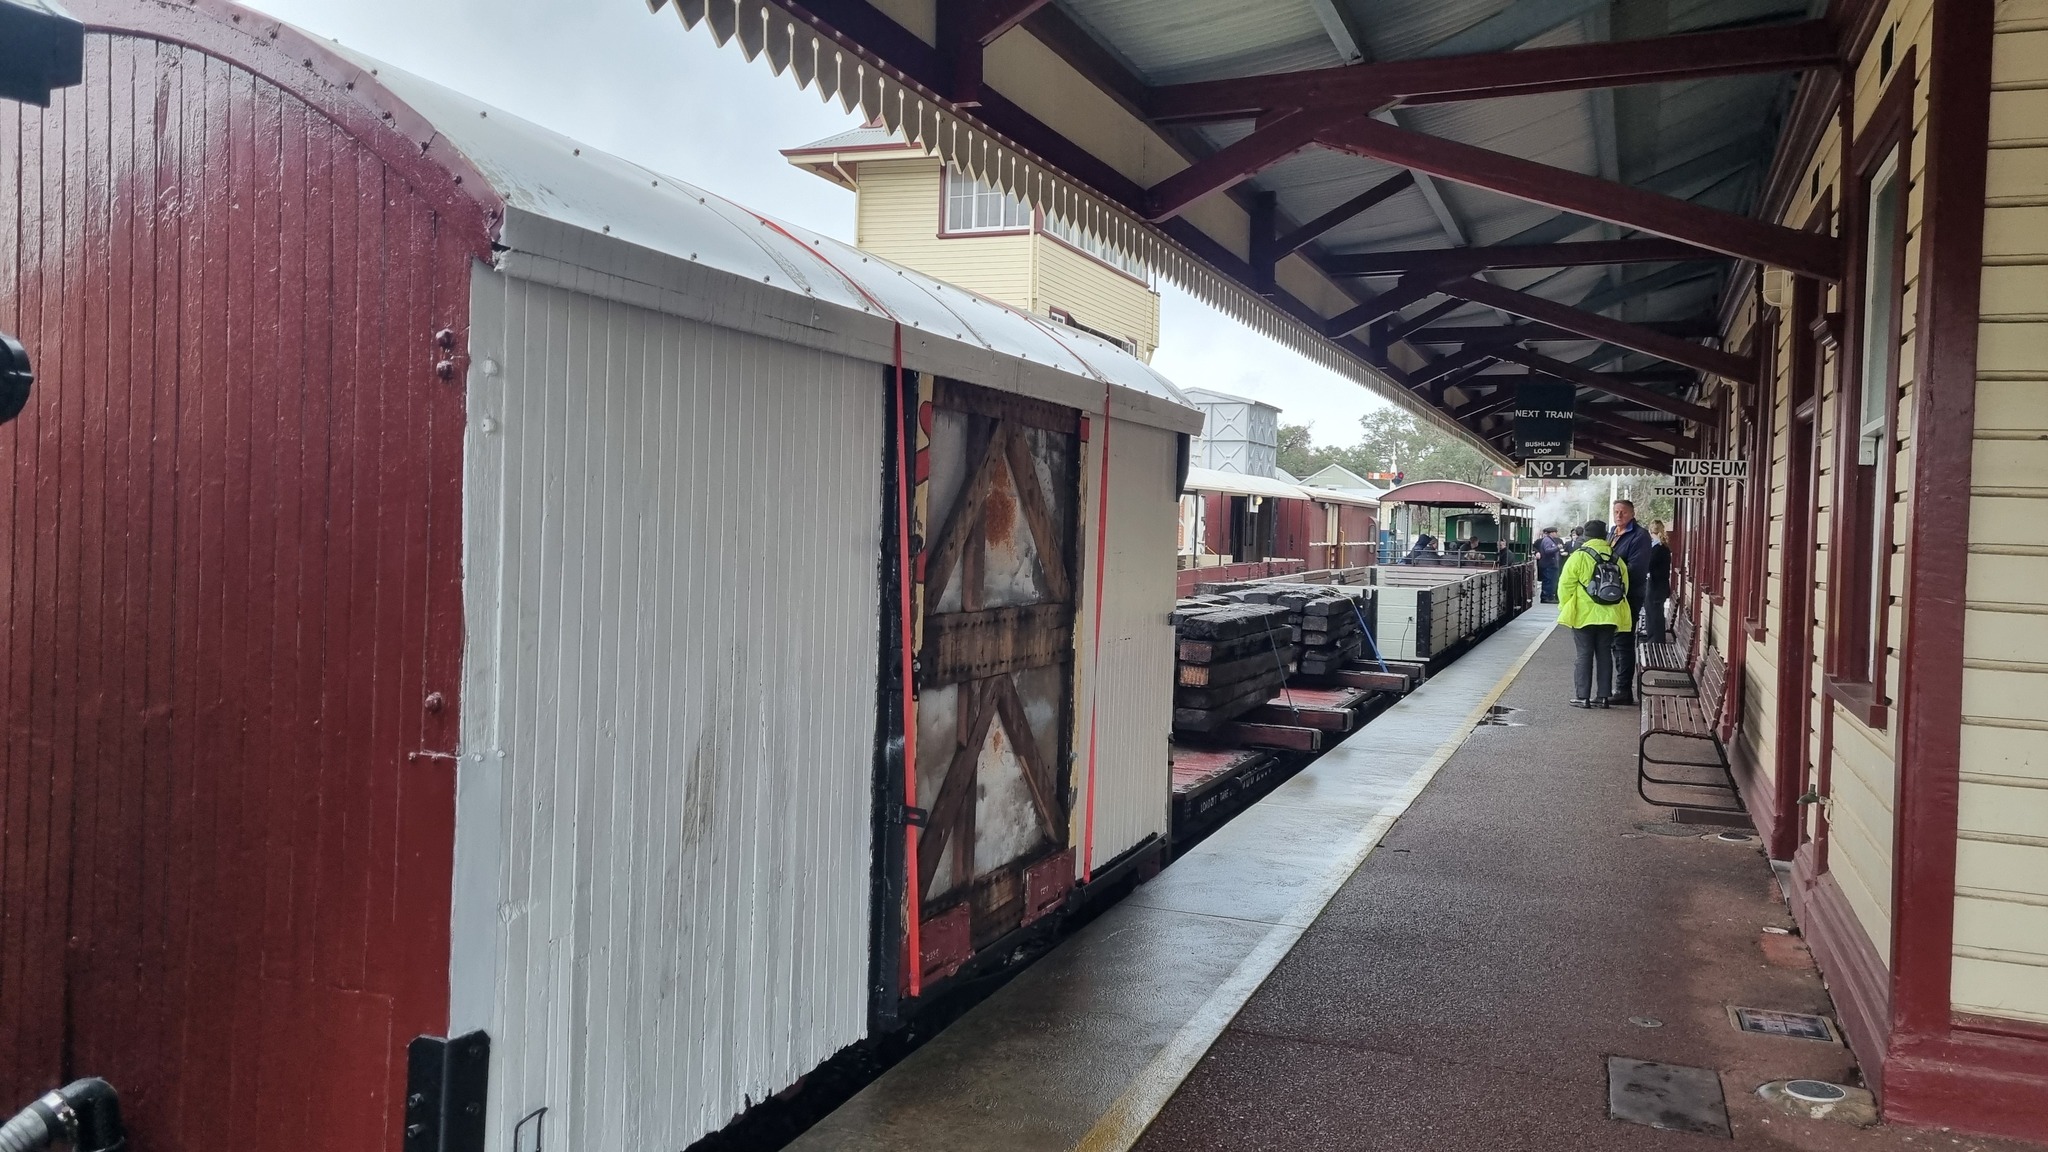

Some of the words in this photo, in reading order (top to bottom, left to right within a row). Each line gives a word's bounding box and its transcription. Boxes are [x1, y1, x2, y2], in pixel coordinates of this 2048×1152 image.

[1515, 409, 1540, 418] NEXT
[1545, 410, 1573, 419] TRAIN
[1556, 461, 1567, 478] 1
[1674, 460, 1747, 476] MUSEUM
[1655, 487, 1705, 496] TICKETS
